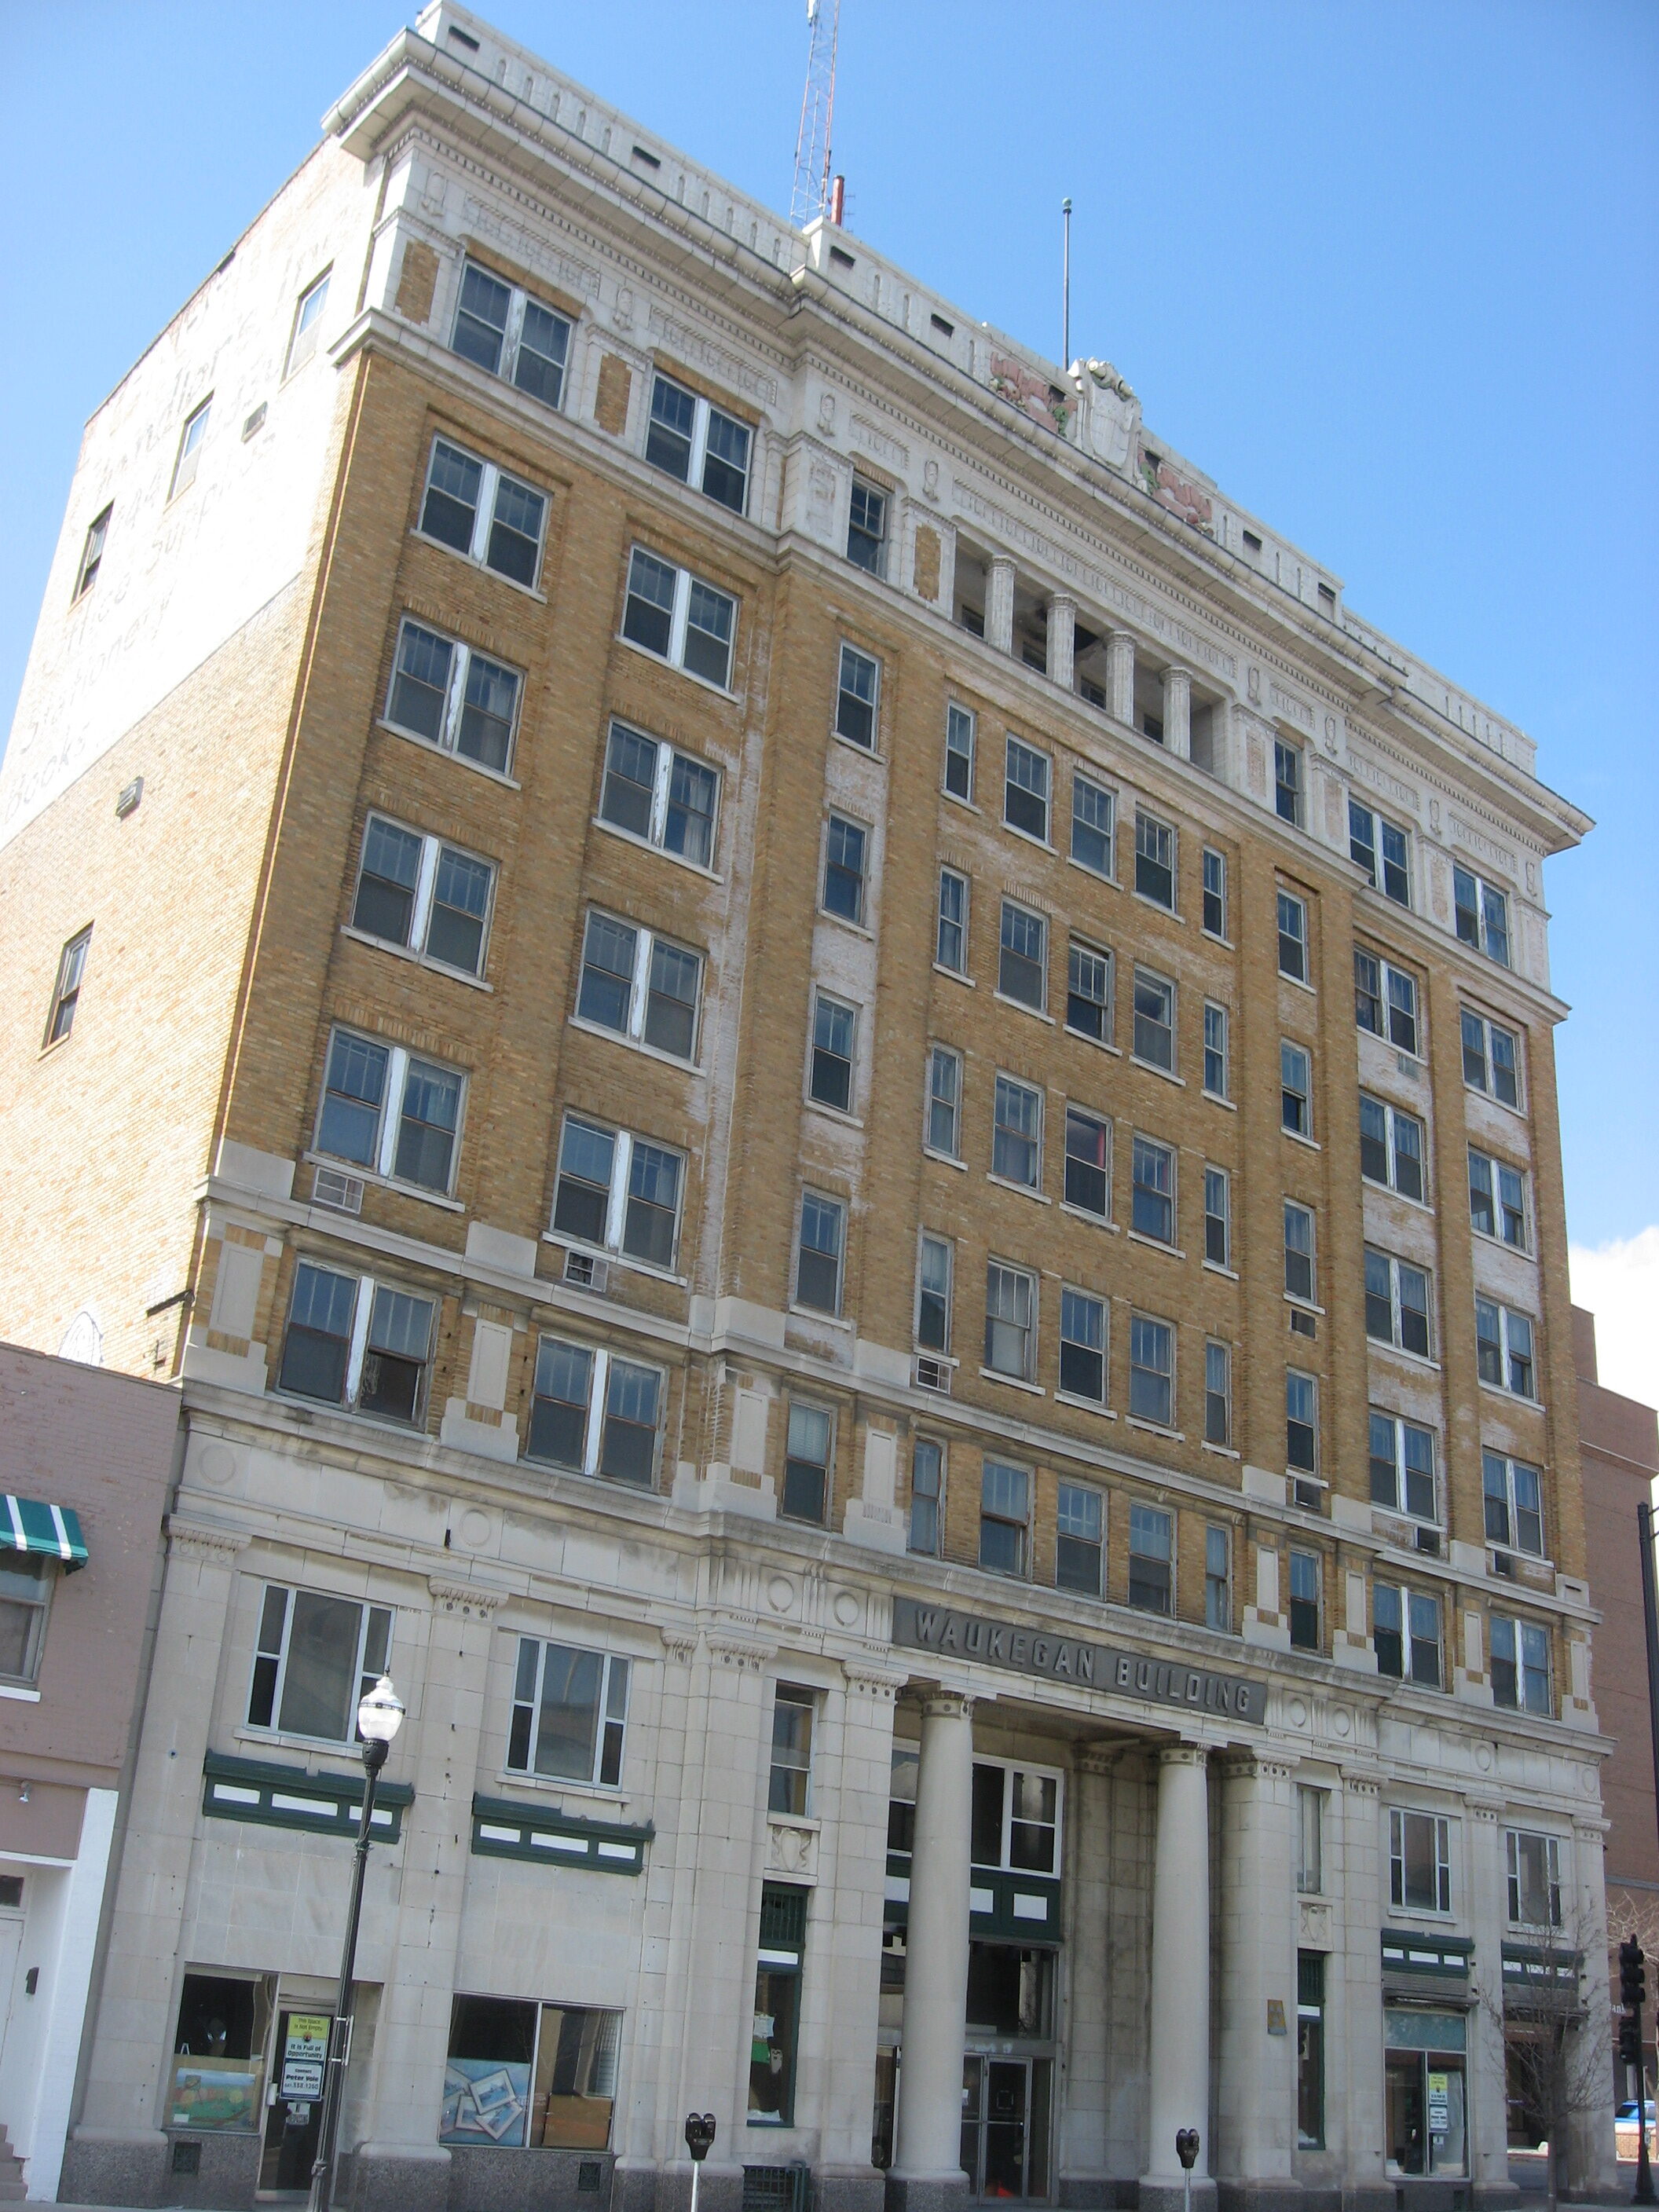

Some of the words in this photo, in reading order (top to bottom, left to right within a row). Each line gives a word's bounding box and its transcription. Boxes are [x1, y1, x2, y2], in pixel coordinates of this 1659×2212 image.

[915, 1609, 1093, 1679] WAUKEGAN
[1115, 1657, 1251, 1713] BUILDING
[287, 2050, 323, 2059] Opportunity
